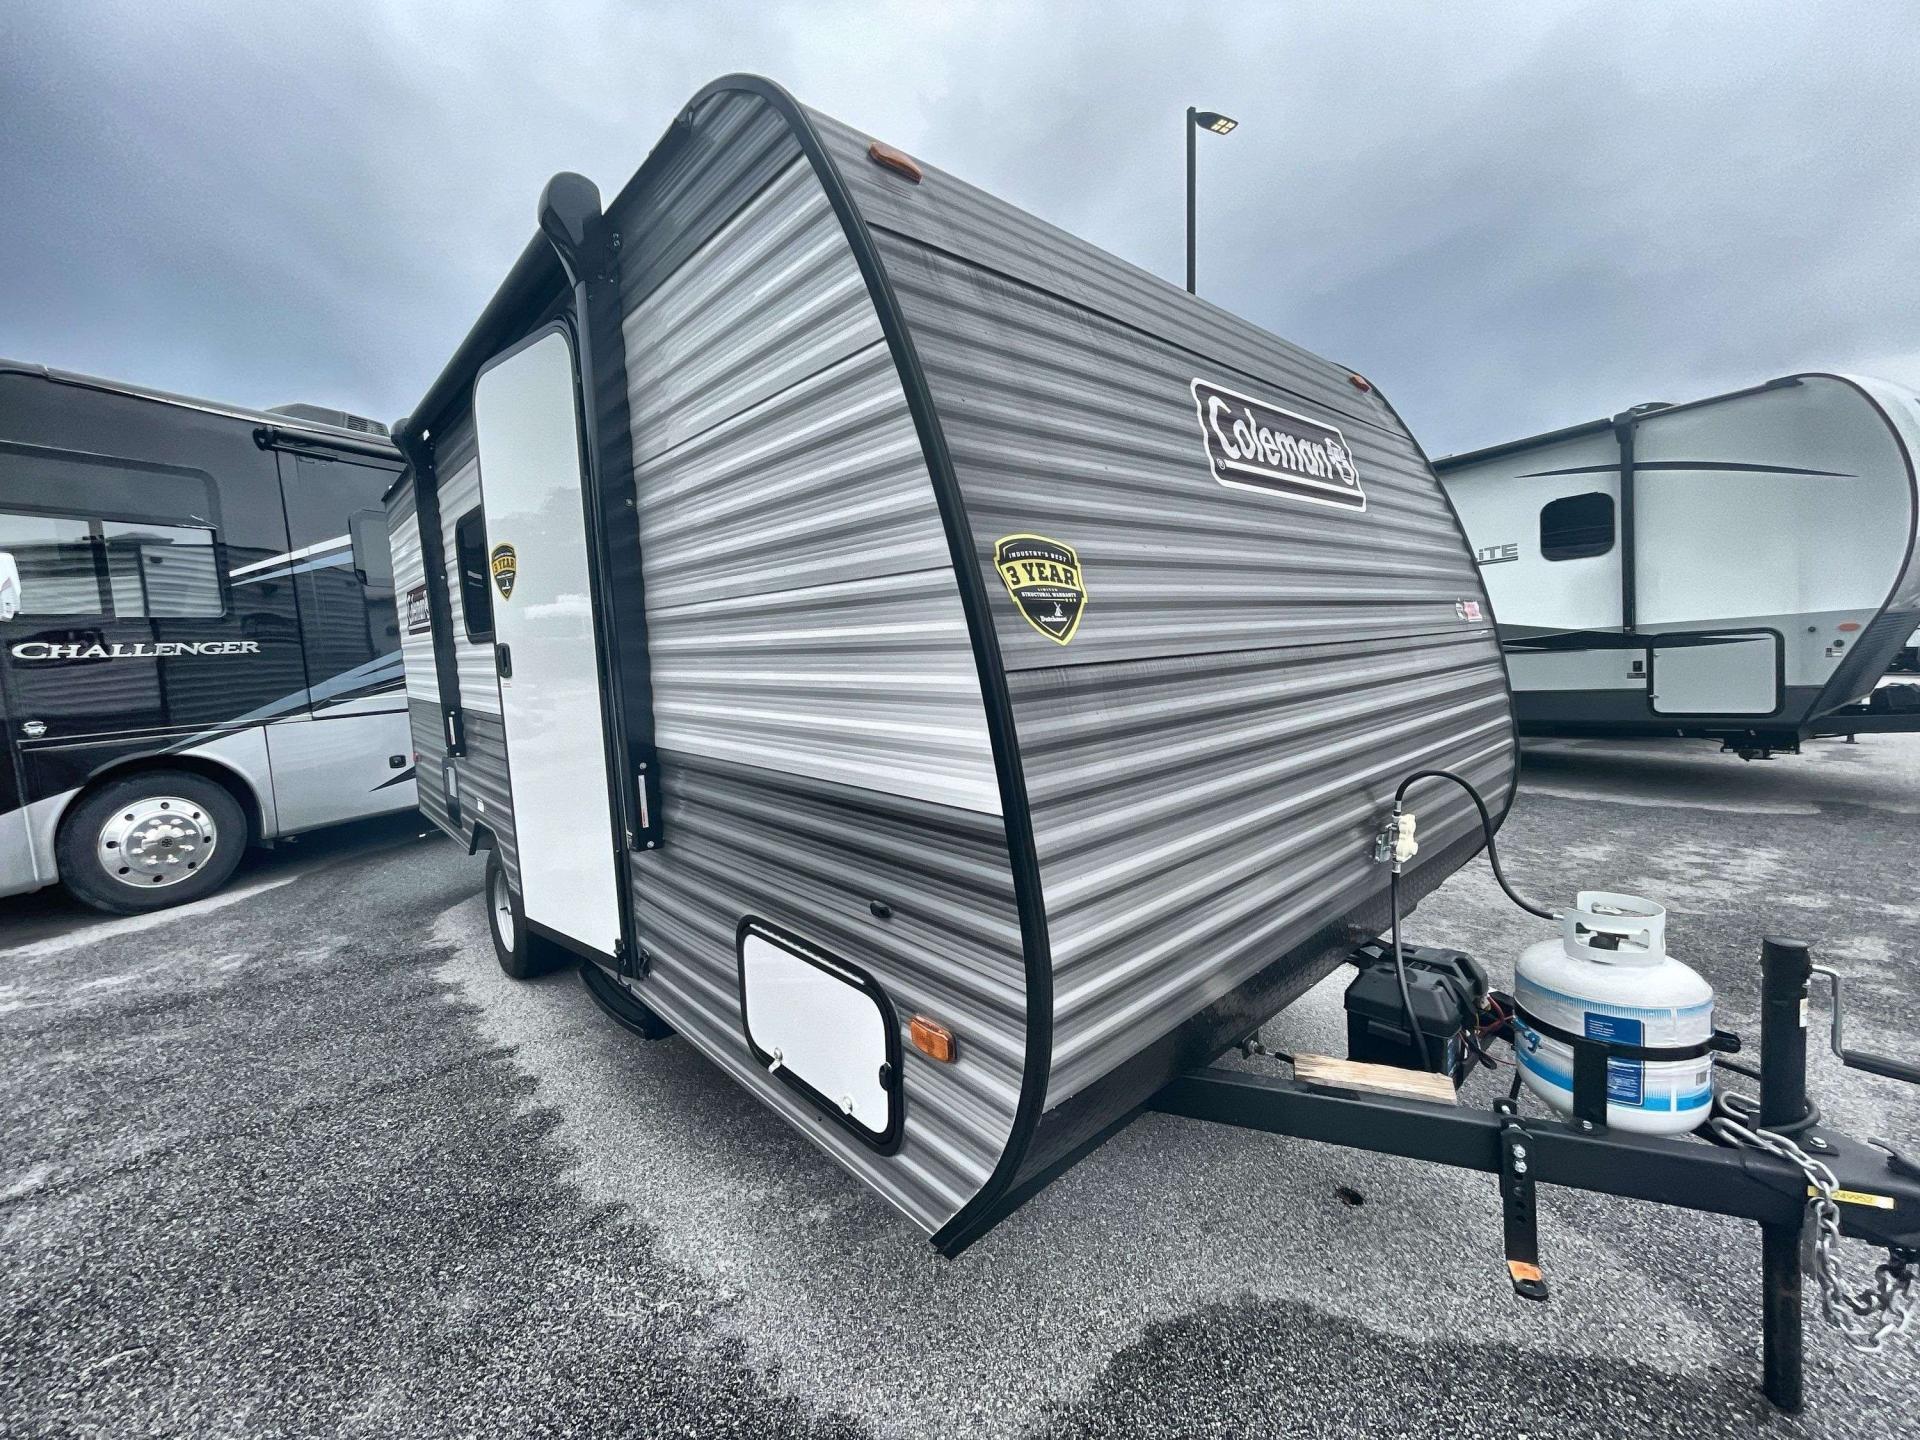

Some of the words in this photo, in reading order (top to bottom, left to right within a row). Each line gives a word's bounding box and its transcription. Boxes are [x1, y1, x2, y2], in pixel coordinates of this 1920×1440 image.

[1208, 396, 1333, 479] Coleman
[1008, 550, 1049, 559] INDUSTRY'S
[1050, 553, 1067, 563] BEST
[1475, 543, 1518, 561] iTE
[1006, 565, 1021, 585] 3
[1021, 562, 1077, 587] YEAR
[11, 641, 261, 659] CHALLENGER
